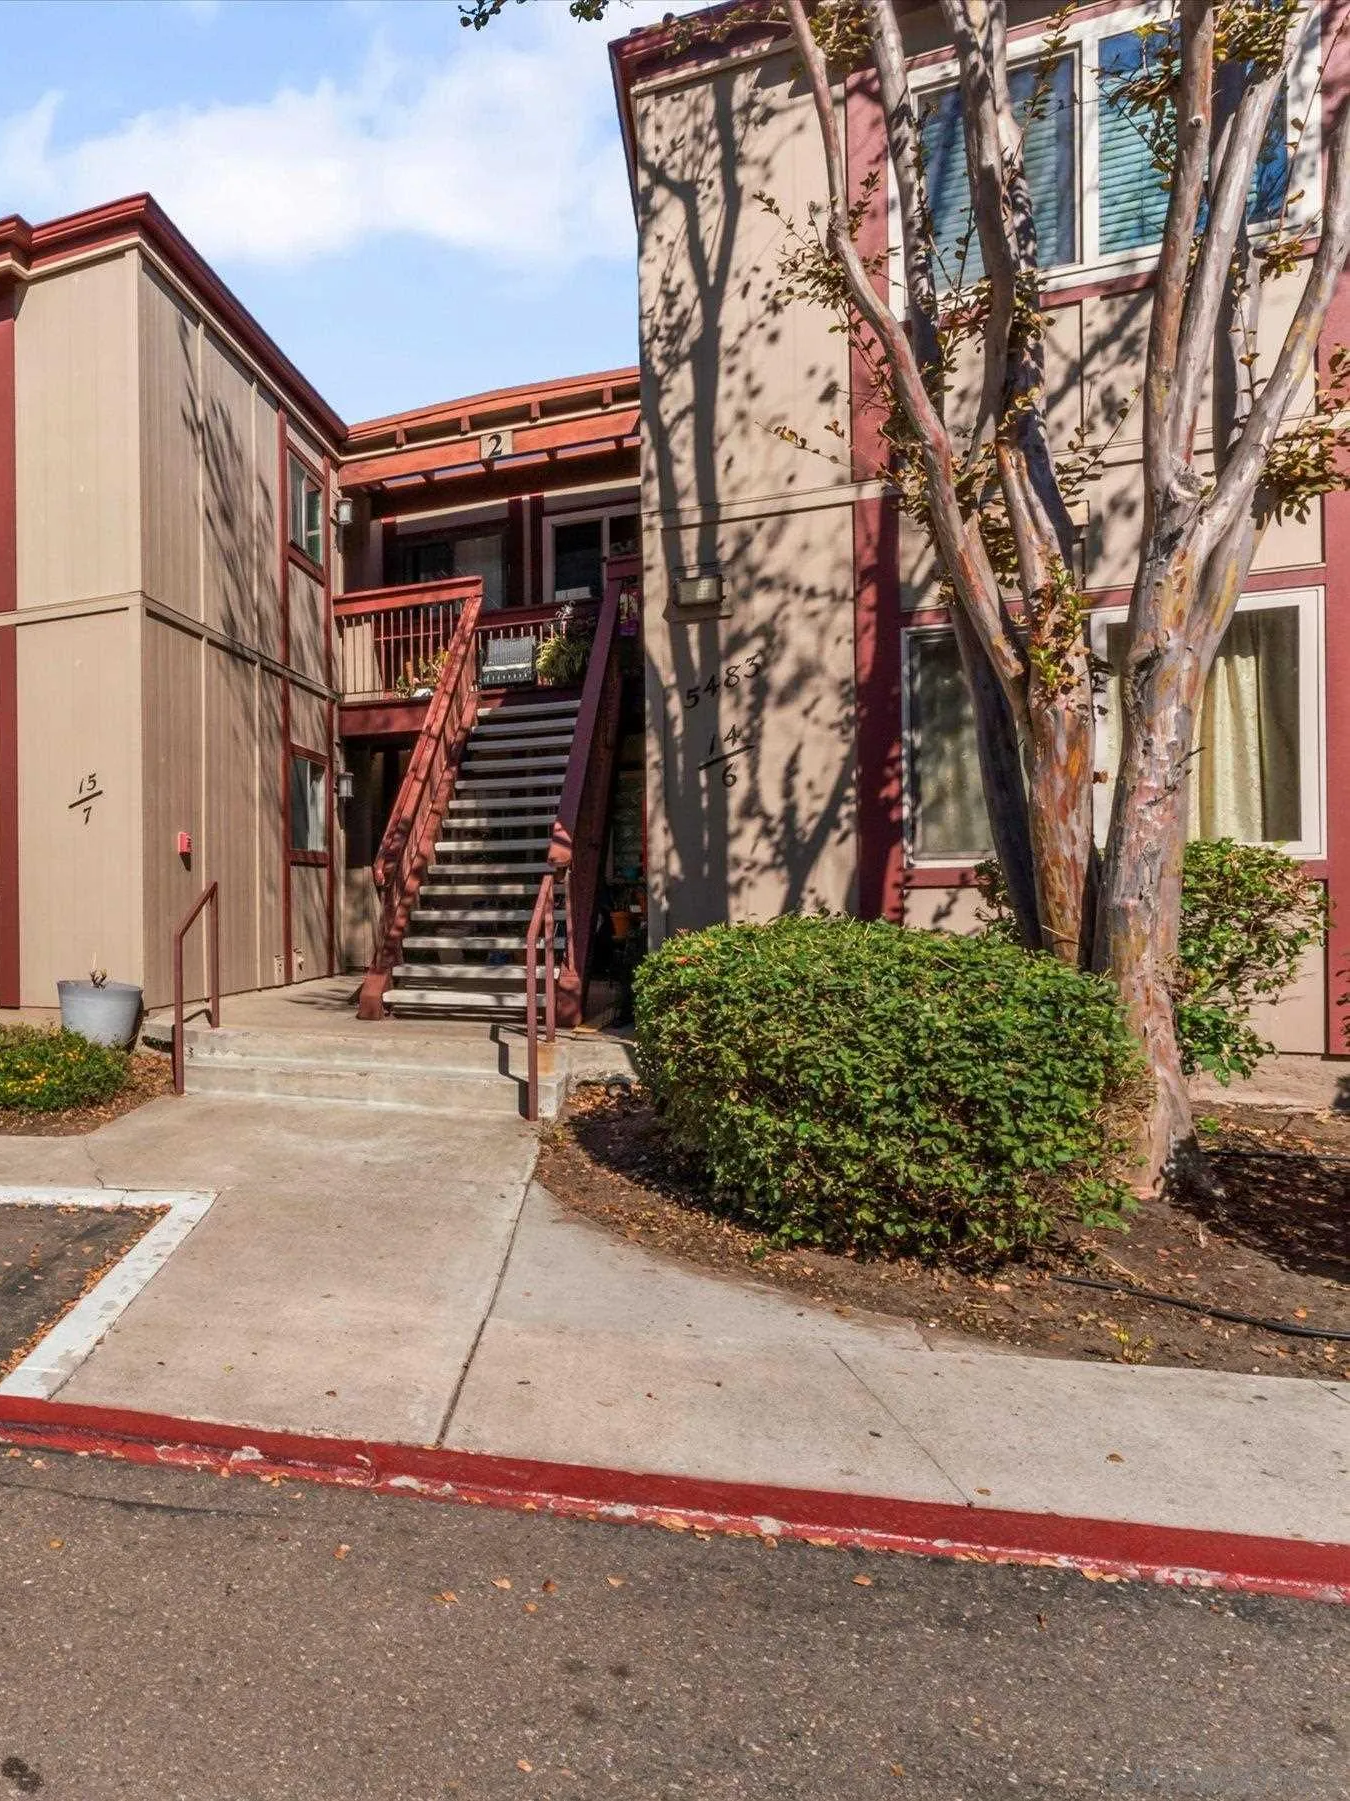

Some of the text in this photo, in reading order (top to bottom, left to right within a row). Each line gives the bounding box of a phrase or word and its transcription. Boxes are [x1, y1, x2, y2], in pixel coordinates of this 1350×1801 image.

[488, 433, 503, 457] 2
[683, 650, 762, 709] 5483
[708, 724, 743, 756] 14
[78, 772, 97, 794] 15
[721, 763, 738, 787] 6
[82, 806, 92, 825] 7
